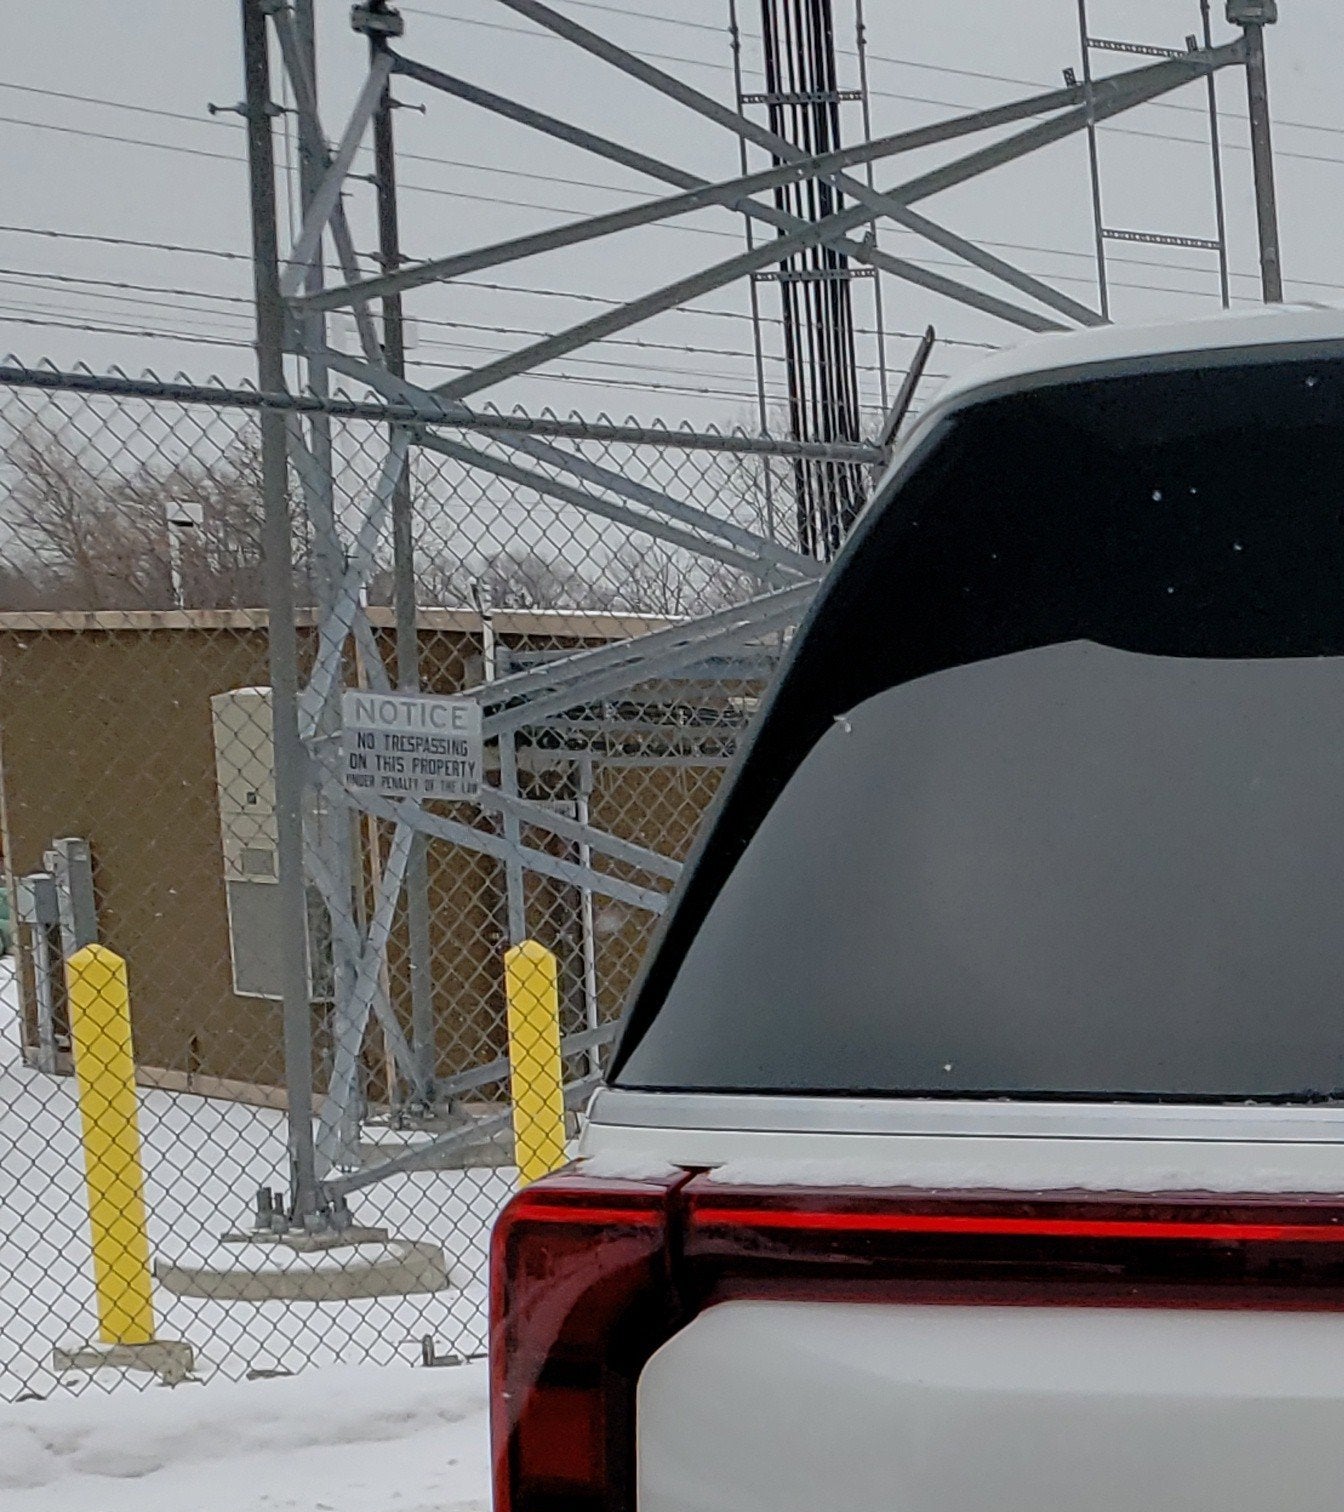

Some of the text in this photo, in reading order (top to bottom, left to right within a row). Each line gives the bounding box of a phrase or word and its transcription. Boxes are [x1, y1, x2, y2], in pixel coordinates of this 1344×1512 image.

[355, 698, 469, 730] NOTICE
[357, 731, 468, 757] NO TRESPASSING
[349, 753, 476, 778] ON THIS PROPERTY
